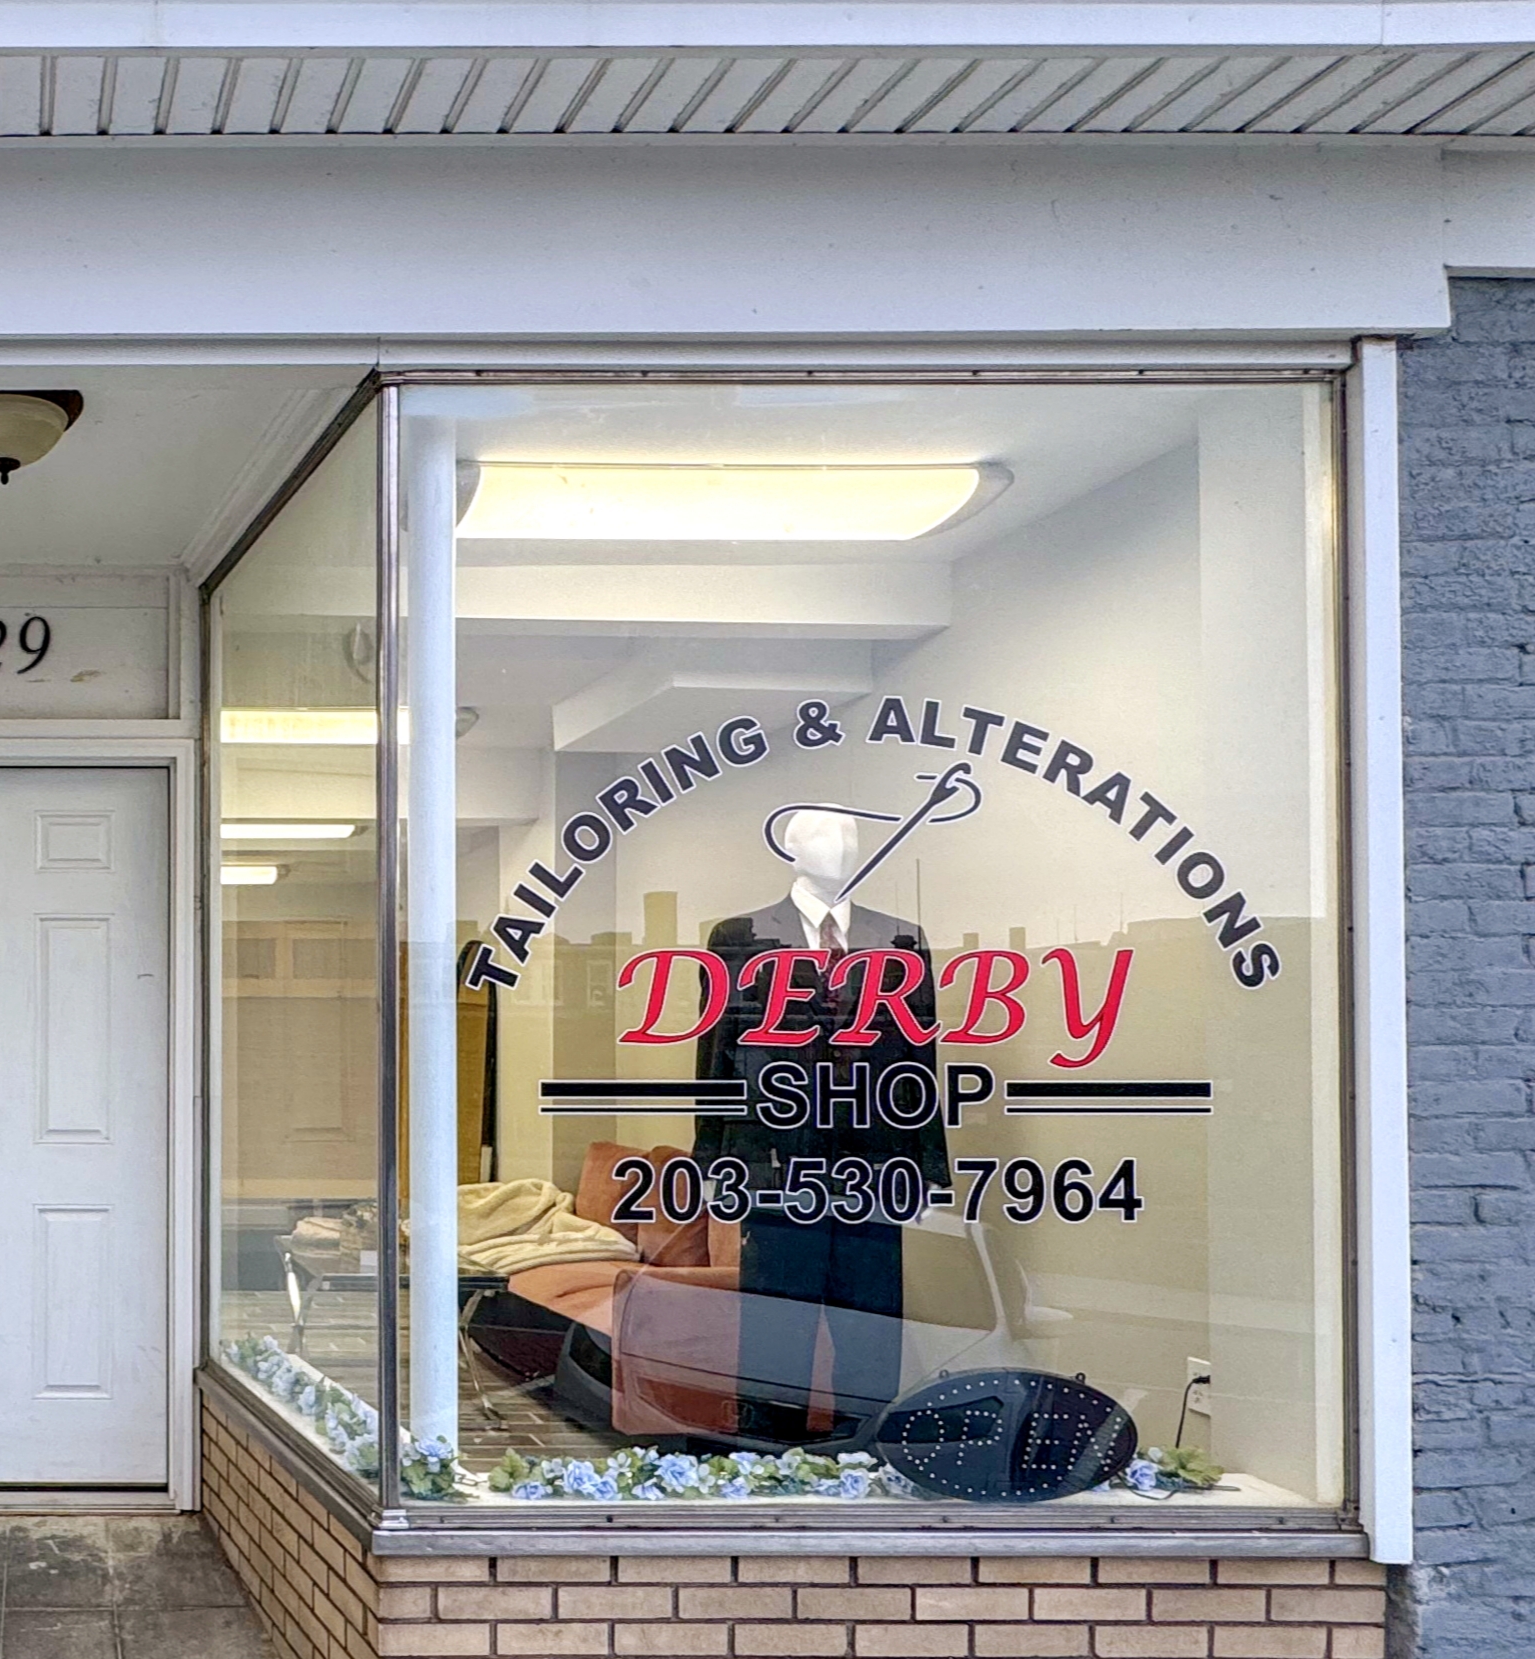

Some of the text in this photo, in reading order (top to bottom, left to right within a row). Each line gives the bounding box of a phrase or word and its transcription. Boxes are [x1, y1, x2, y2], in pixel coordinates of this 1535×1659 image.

[465, 695, 1281, 992] TAILORING & ALTERATIONS
[615, 946, 1136, 1069] DERBY
[754, 1061, 997, 1130] SHOP
[609, 1155, 1145, 1225] 203-530-7964
[902, 1409, 1122, 1472] OPEN
